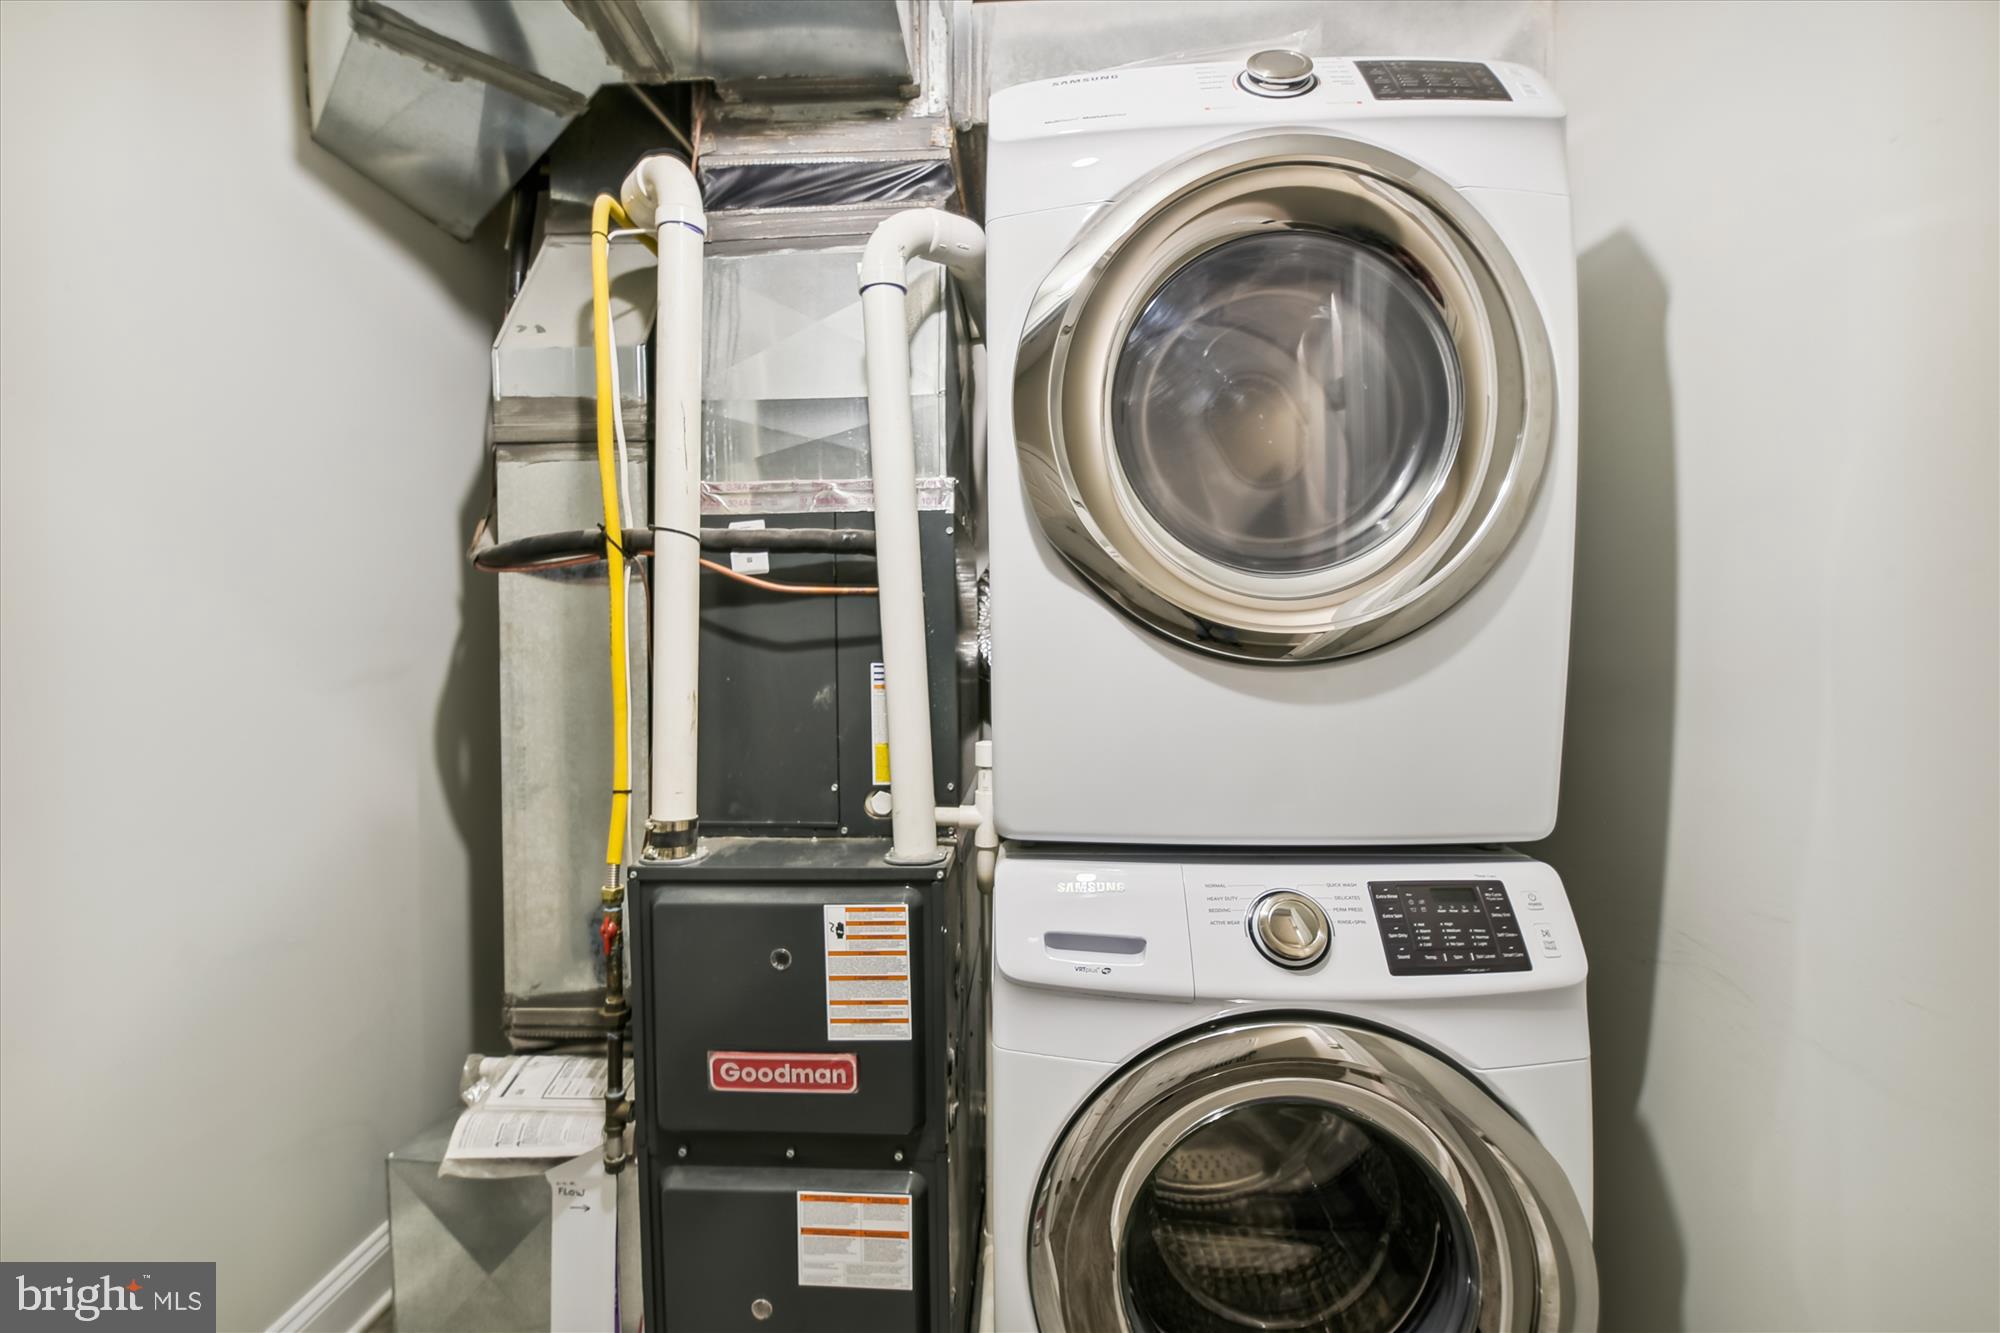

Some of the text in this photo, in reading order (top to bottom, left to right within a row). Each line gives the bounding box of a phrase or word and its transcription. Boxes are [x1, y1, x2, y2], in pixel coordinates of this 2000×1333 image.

[1052, 74, 1118, 86] SAMSUNG
[1057, 881, 1126, 893] SAMSUNG
[720, 1062, 847, 1084] Goodman
[557, 1186, 586, 1198] FLOW
